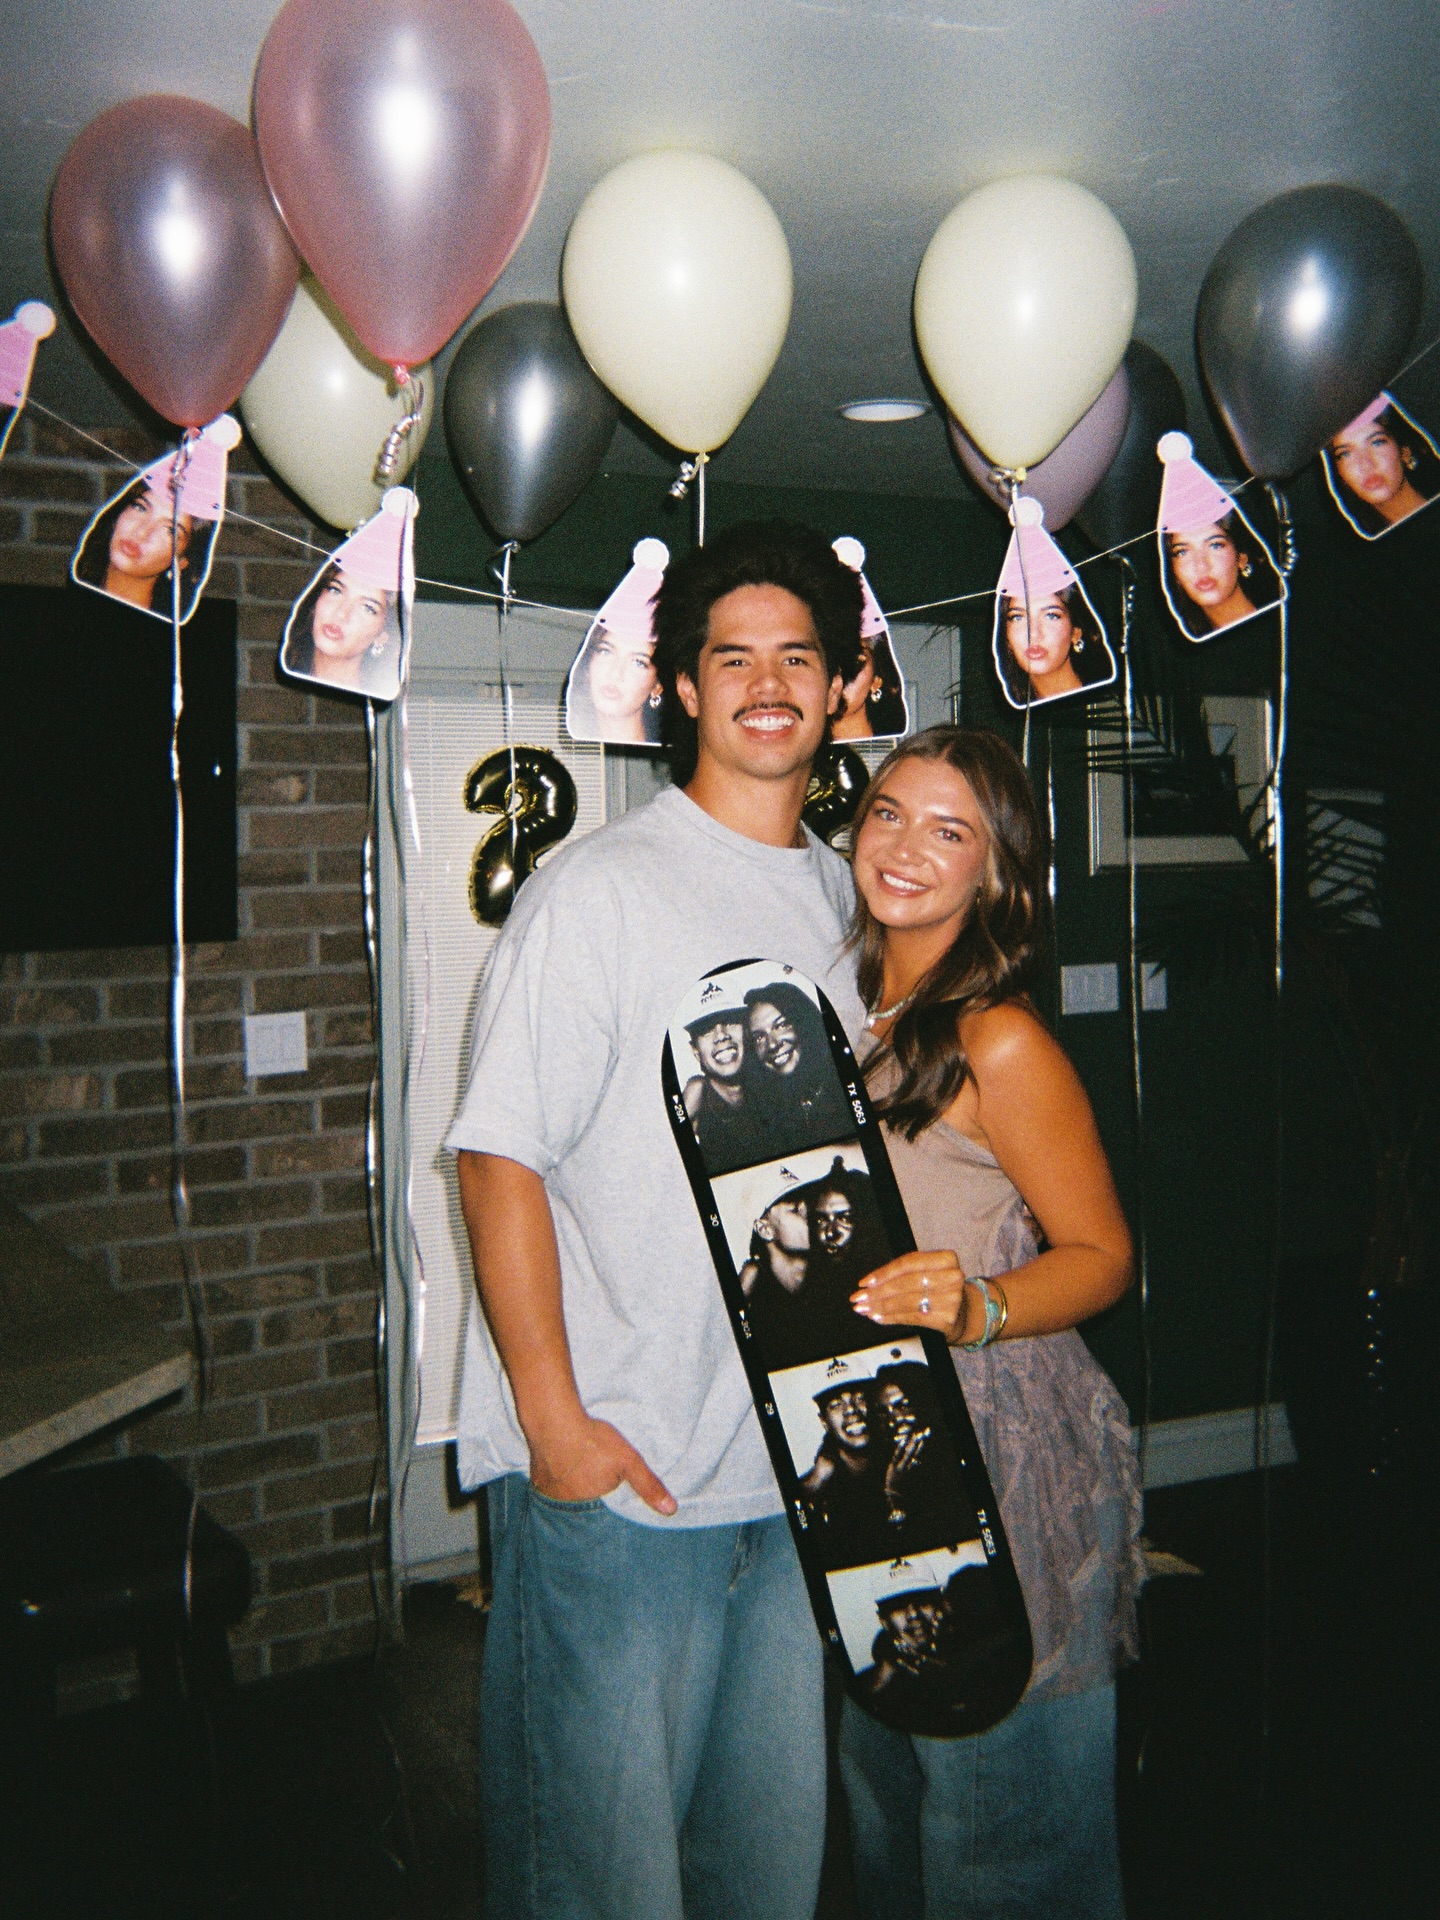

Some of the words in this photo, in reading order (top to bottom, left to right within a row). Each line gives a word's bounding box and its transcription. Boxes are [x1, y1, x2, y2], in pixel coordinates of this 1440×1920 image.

[847, 1081, 858, 1097] TX
[673, 1103, 686, 1124] 29A
[852, 1099, 867, 1125] 5063
[709, 1213, 720, 1227] 30
[764, 1402, 775, 1416] 29
[977, 1508, 988, 1525] TX
